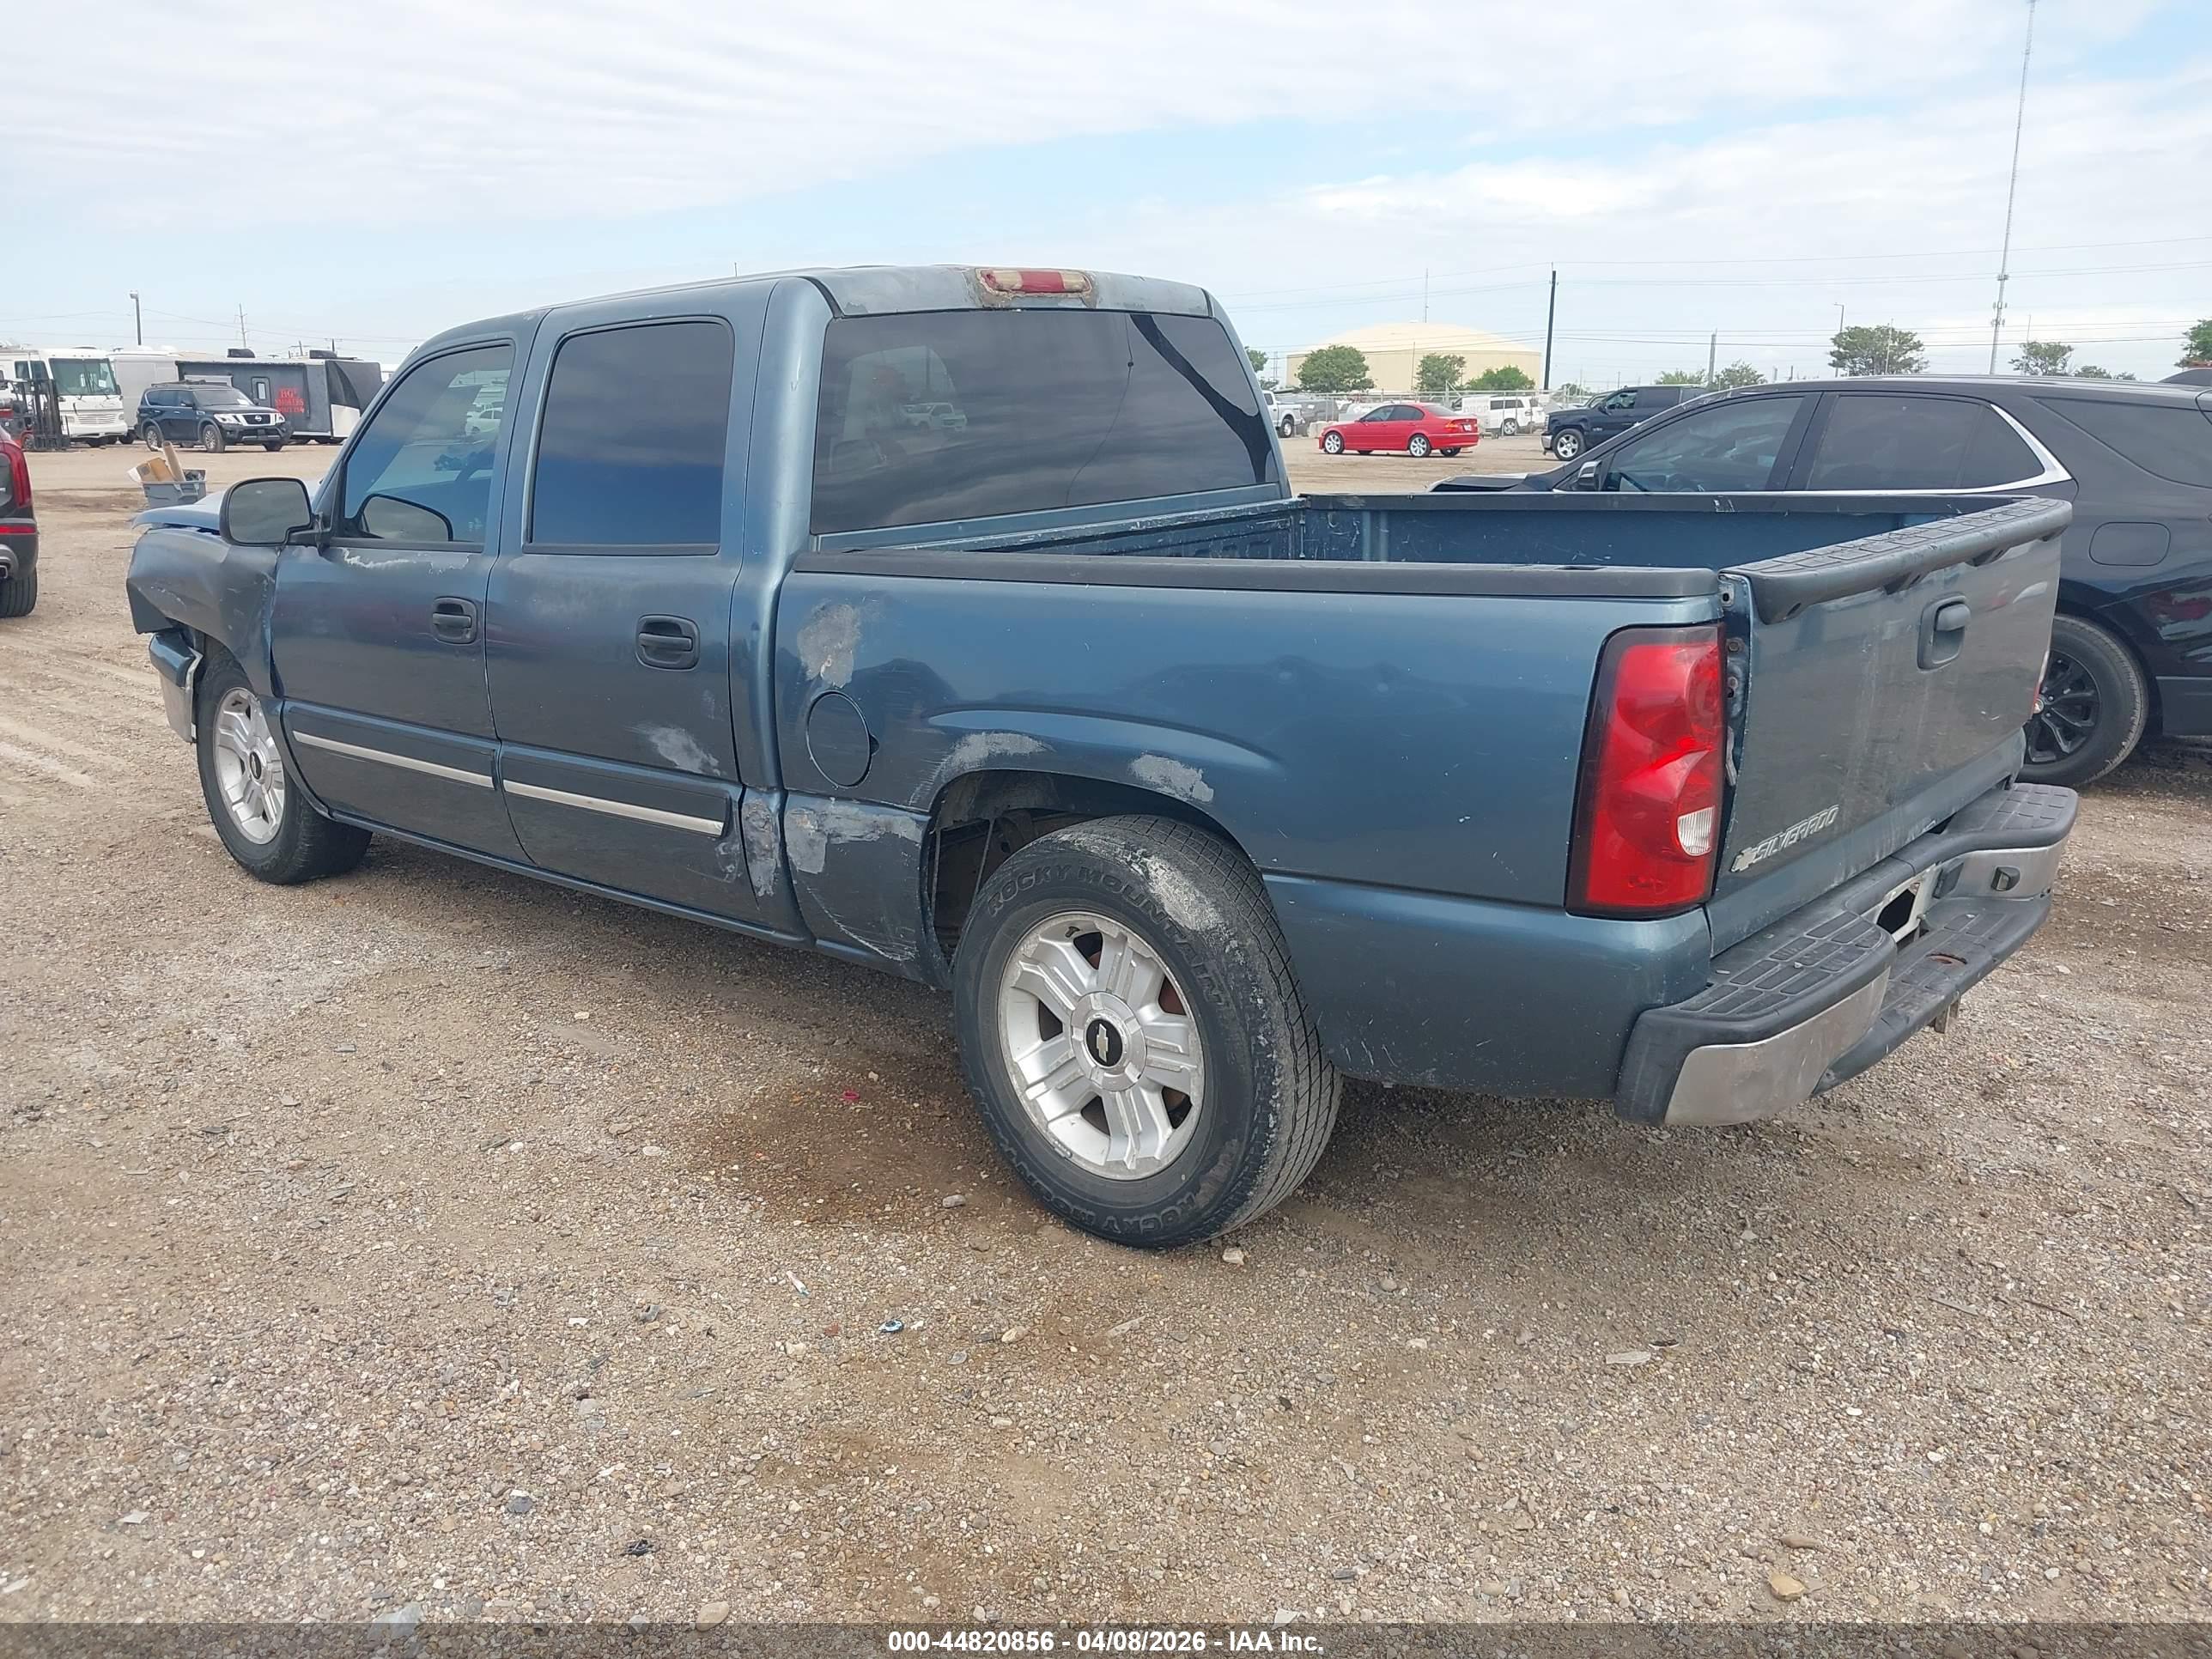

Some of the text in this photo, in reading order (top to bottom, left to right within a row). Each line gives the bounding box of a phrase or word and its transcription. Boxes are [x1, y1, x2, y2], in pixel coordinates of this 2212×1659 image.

[1754, 804, 1839, 862] SILVERADO
[988, 864, 1224, 1006] ROCKY MOUNTAIN
[1103, 1192, 1196, 1237] ROCKY
